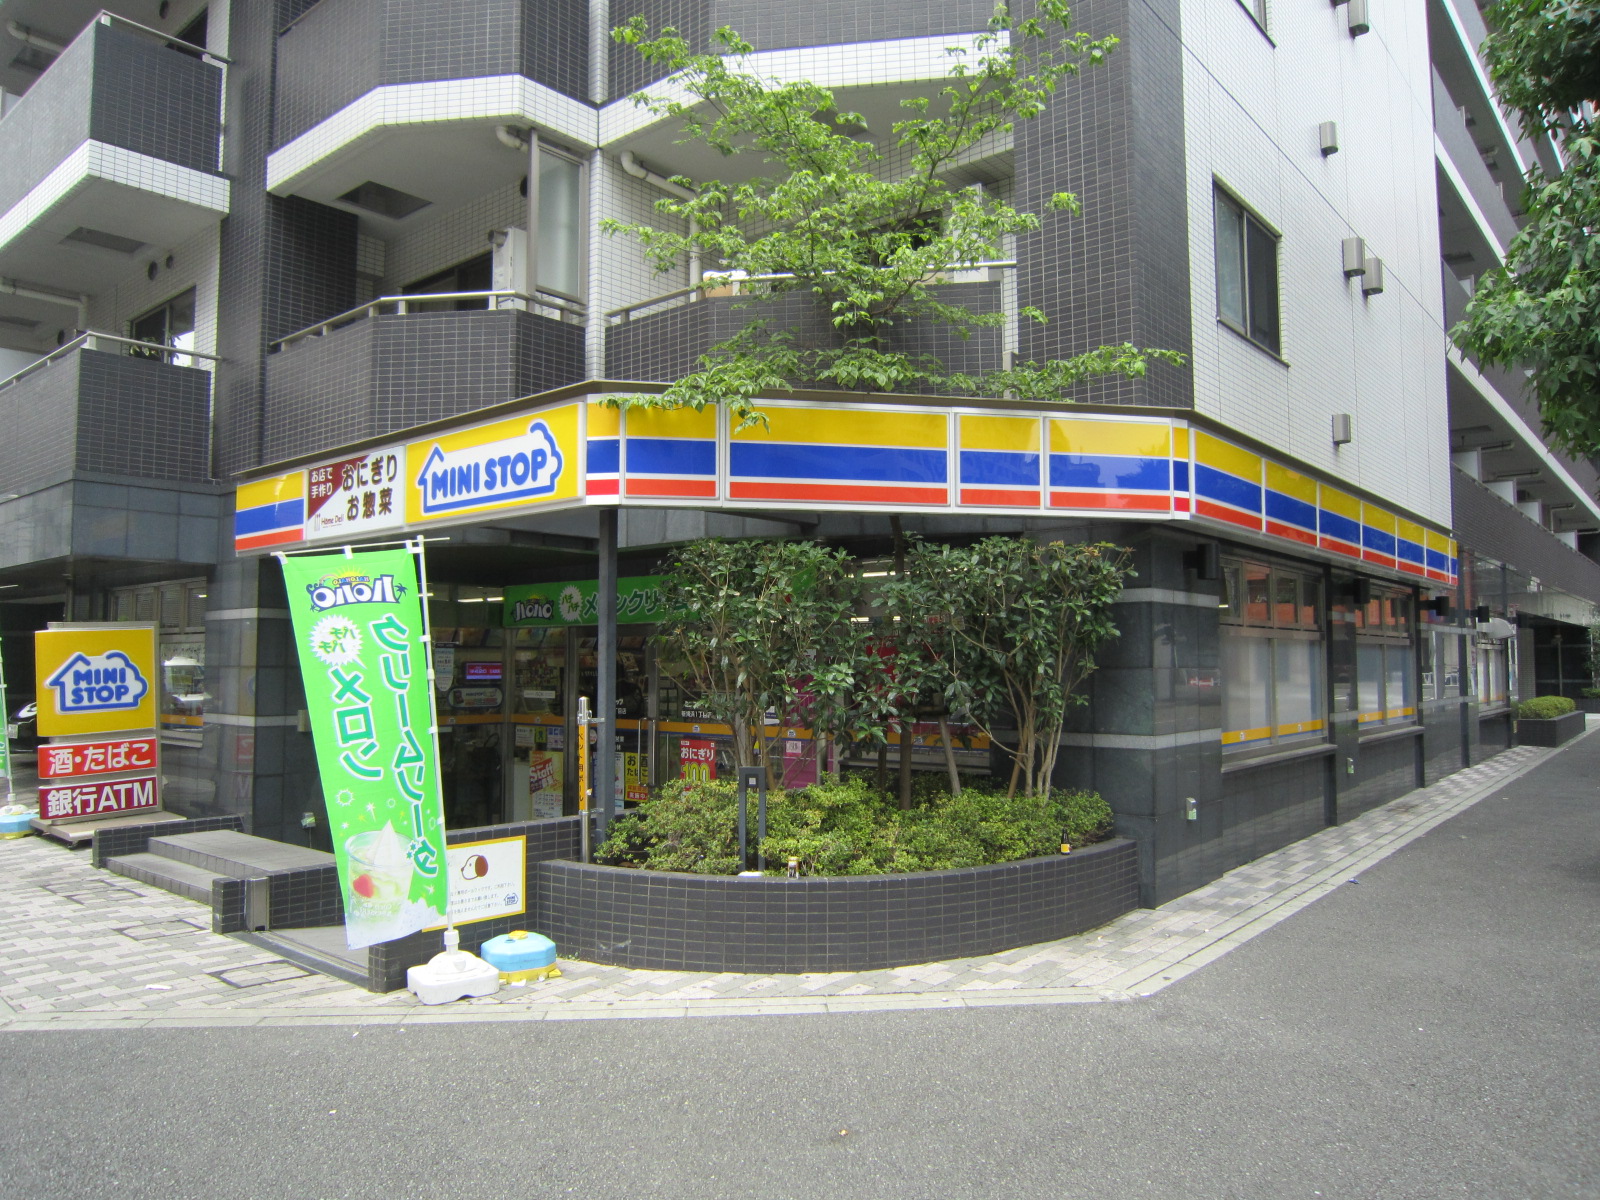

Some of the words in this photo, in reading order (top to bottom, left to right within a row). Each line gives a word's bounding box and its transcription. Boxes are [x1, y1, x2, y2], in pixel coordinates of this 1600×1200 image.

[311, 467, 333, 482] お店で
[342, 454, 397, 492] おにぎり
[431, 461, 480, 501] MINI
[484, 447, 548, 490] STOP
[311, 483, 333, 498] 手作り
[347, 487, 393, 521] お惣菜
[335, 513, 344, 524] Deli
[73, 667, 126, 687] MINI
[71, 686, 129, 704] STOP
[680, 747, 714, 761] おにぎり
[529, 762, 553, 781] Staff
[47, 780, 154, 817] 銀行ATM
